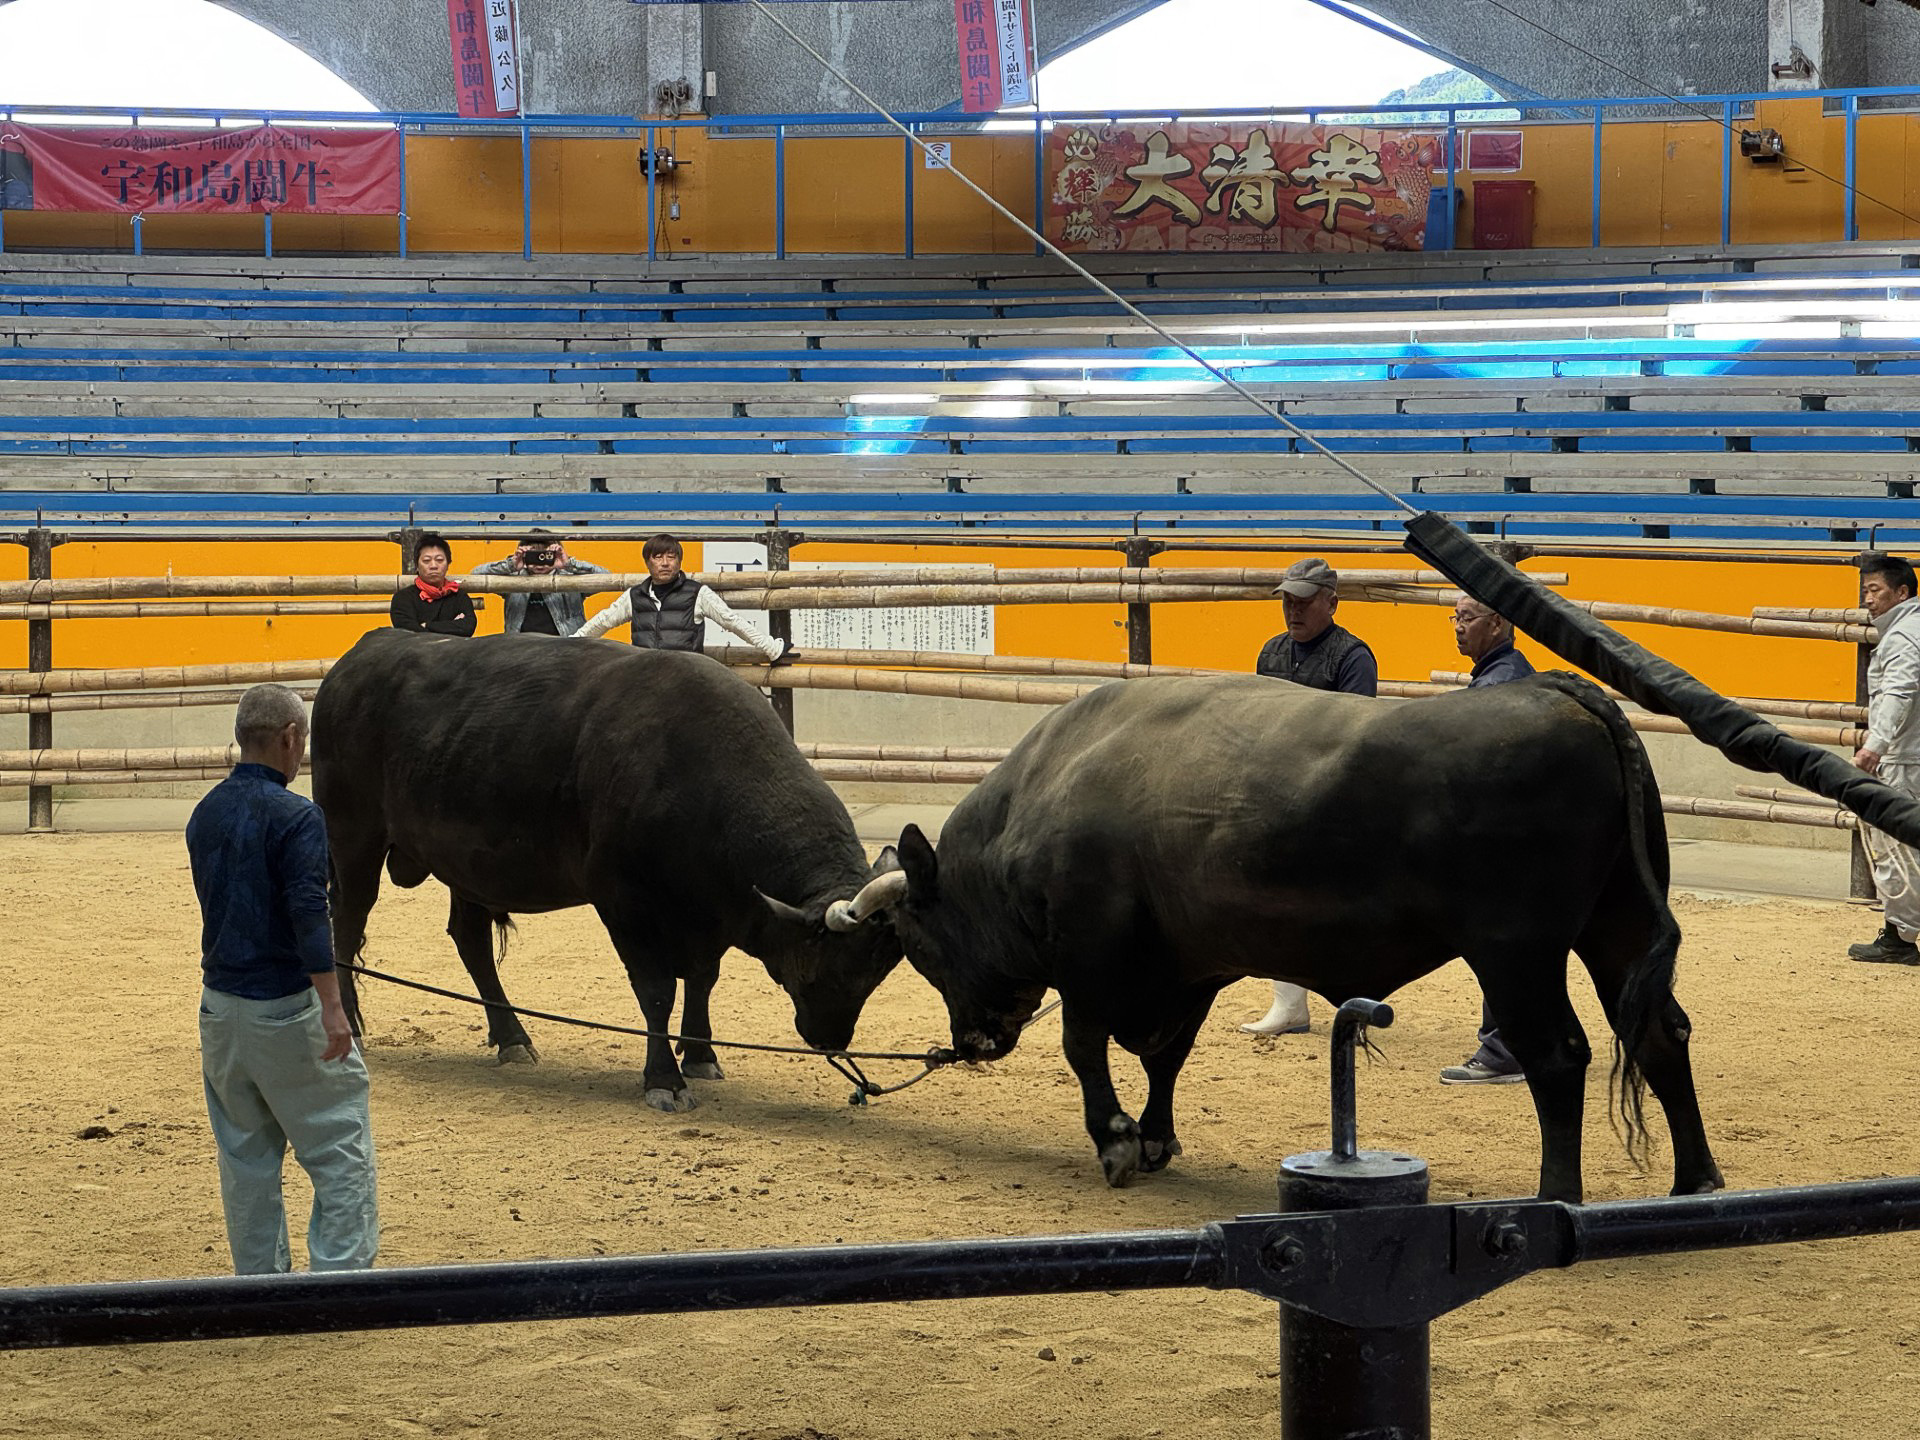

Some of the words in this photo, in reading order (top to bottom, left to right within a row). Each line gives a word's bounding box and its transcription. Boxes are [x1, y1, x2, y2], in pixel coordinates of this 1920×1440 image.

[101, 160, 334, 205] 宇和島闘牛
